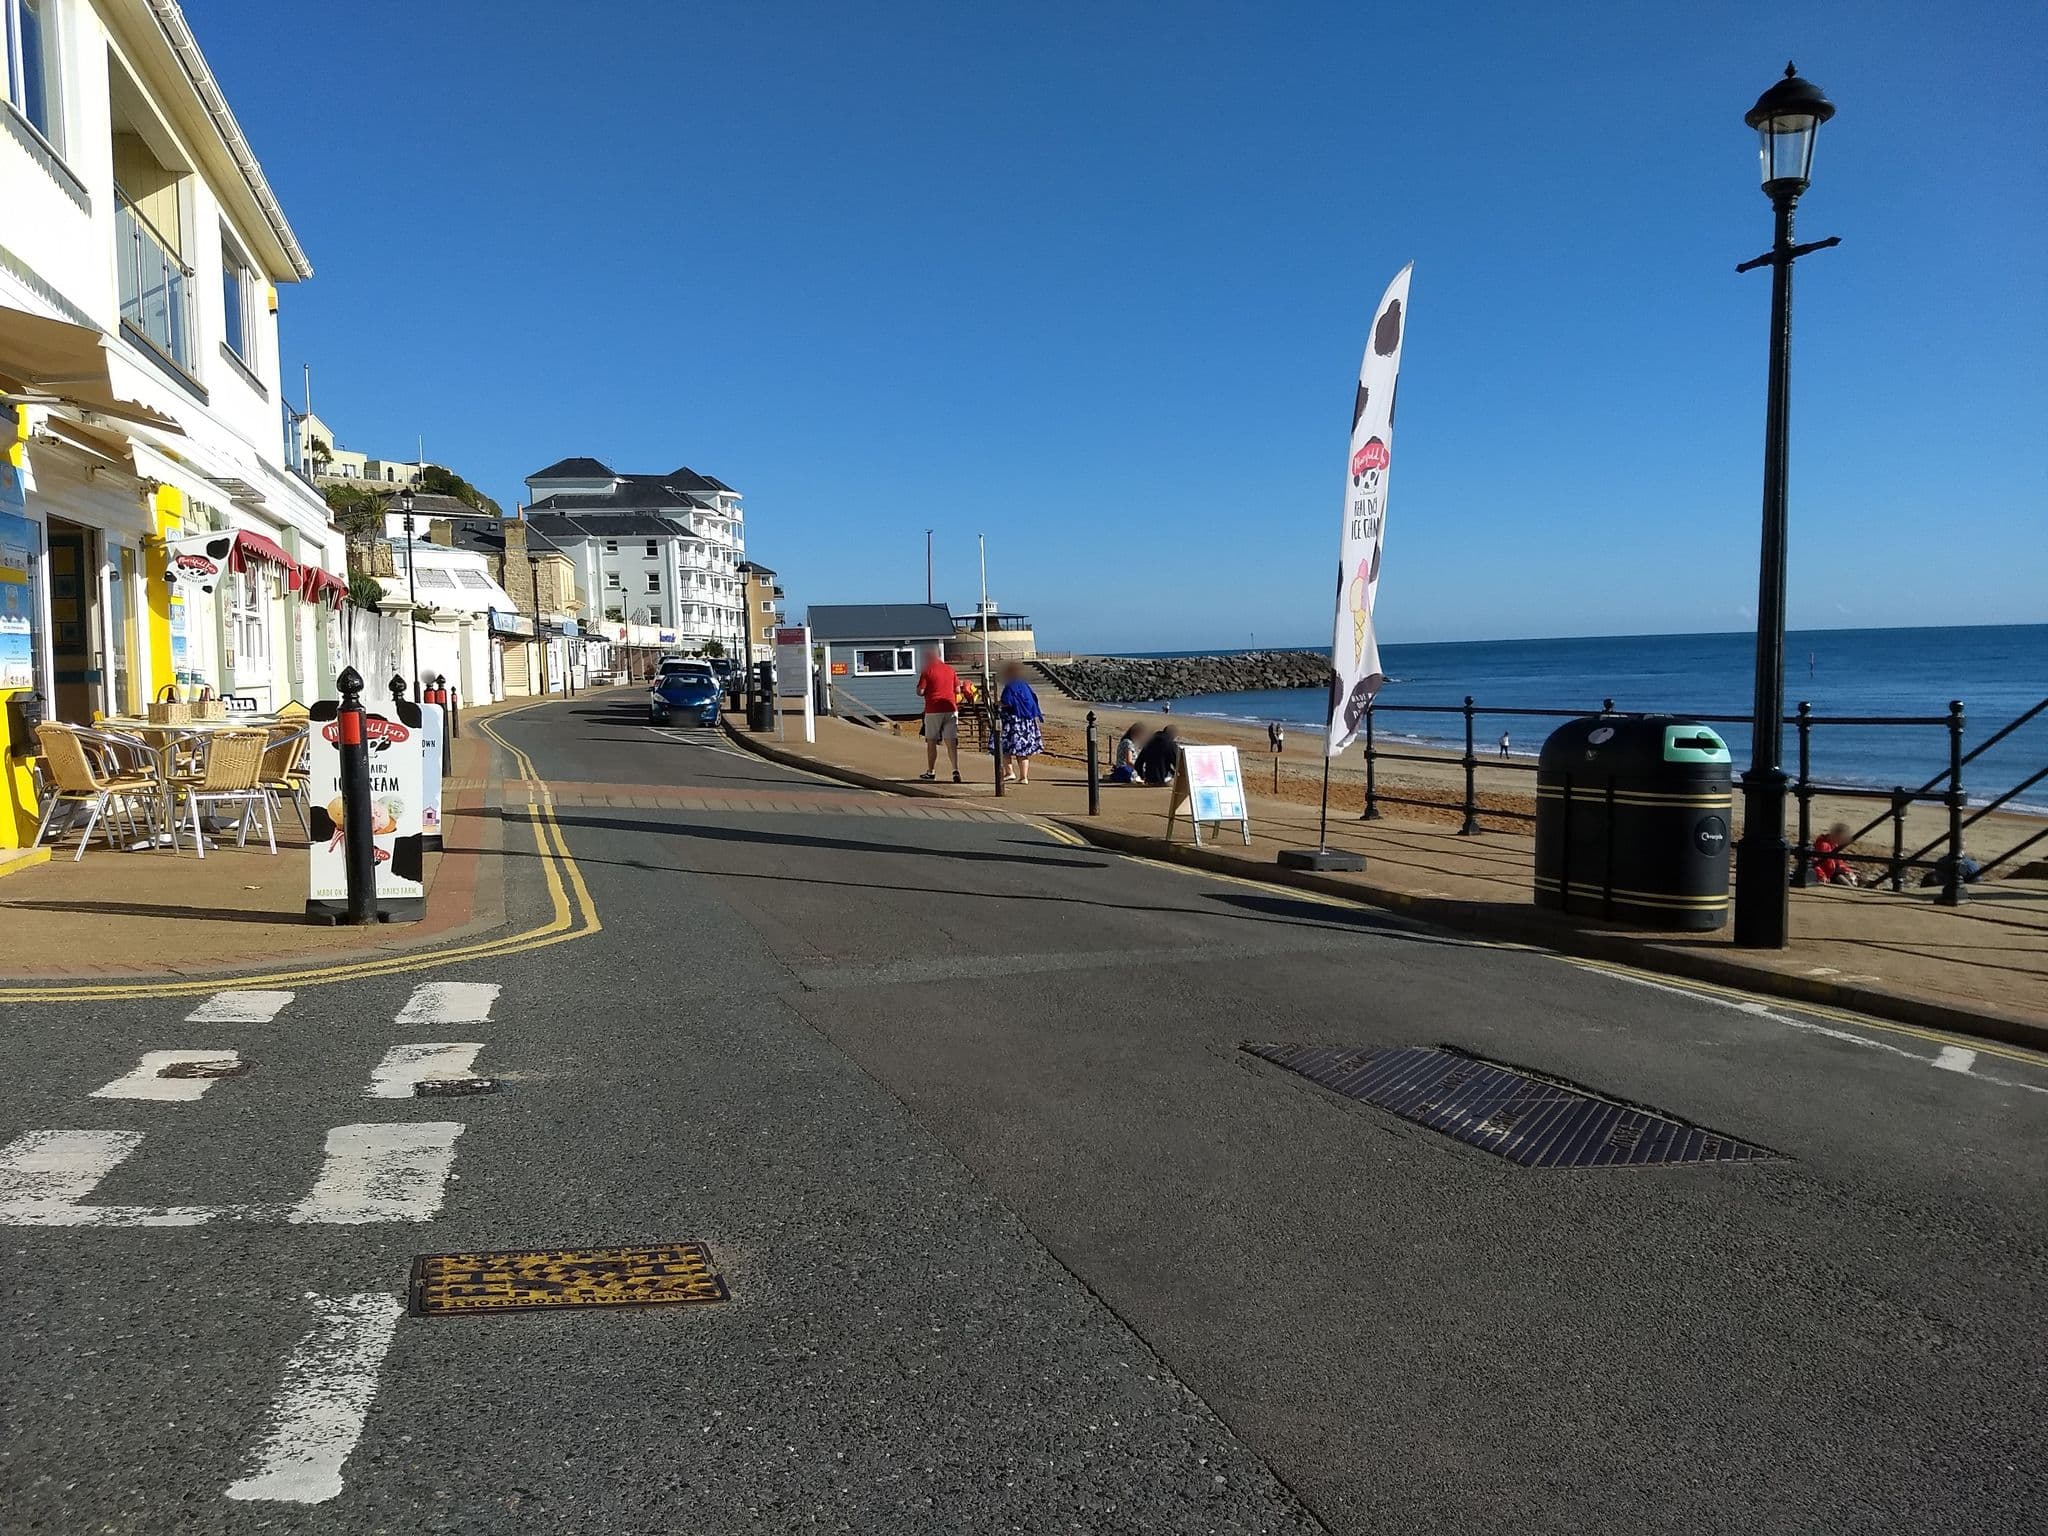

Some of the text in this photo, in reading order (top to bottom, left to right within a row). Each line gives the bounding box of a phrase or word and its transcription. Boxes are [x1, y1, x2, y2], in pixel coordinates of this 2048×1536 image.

[1351, 520, 1361, 540] ICE
[371, 764, 388, 774] AIRY
[370, 777, 400, 792] REAM
